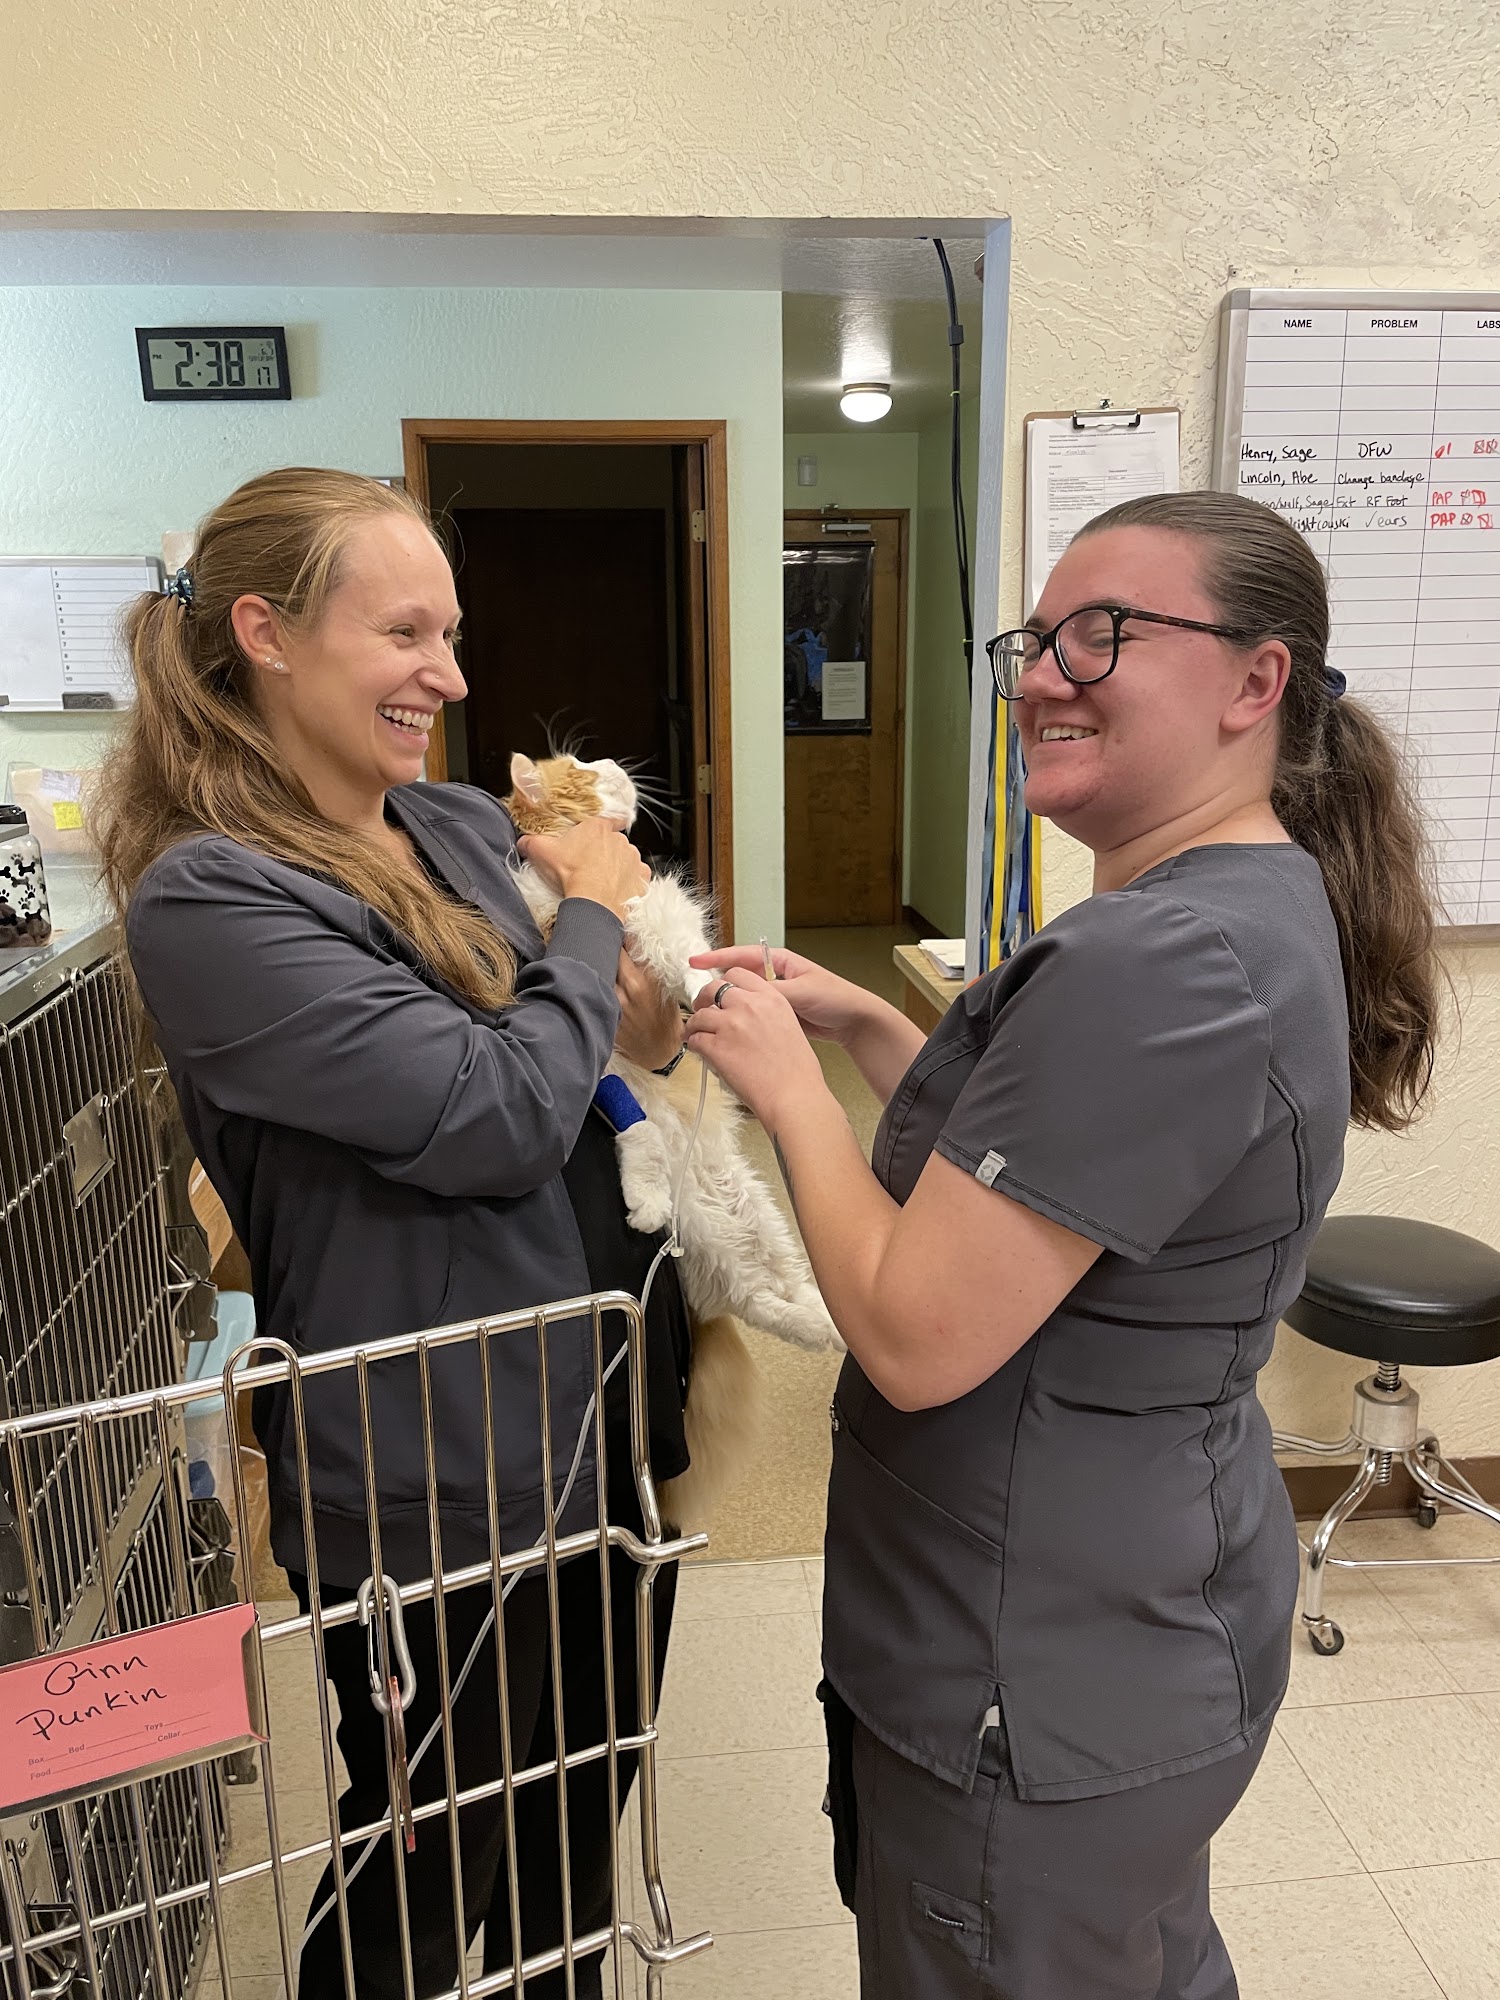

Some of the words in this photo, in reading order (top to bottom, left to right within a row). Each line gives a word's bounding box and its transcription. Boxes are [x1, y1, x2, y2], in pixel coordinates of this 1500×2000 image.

[1283, 319, 1313, 329] NAME
[1371, 319, 1418, 329] PROBLEM
[1477, 320, 1500, 330] LABS
[174, 341, 246, 388] 2:38
[257, 366, 271, 386] 17
[1241, 442, 1277, 464] Henry,
[1282, 445, 1317, 463] Sage
[1358, 441, 1393, 459] DFW
[1241, 470, 1286, 487] Lincoln,
[1292, 470, 1318, 484] Abe
[1338, 472, 1375, 490] Change
[1380, 470, 1425, 489] bandage
[1432, 491, 1453, 506] PAP
[1430, 512, 1456, 529] PAP
[15, 1688, 168, 1741] Punkin
[28, 1755, 45, 1767] Box
[68, 1744, 86, 1755] Bed
[144, 1721, 165, 1734] Toys
[30, 1768, 52, 1781] Food
[157, 1731, 182, 1743] Collar
